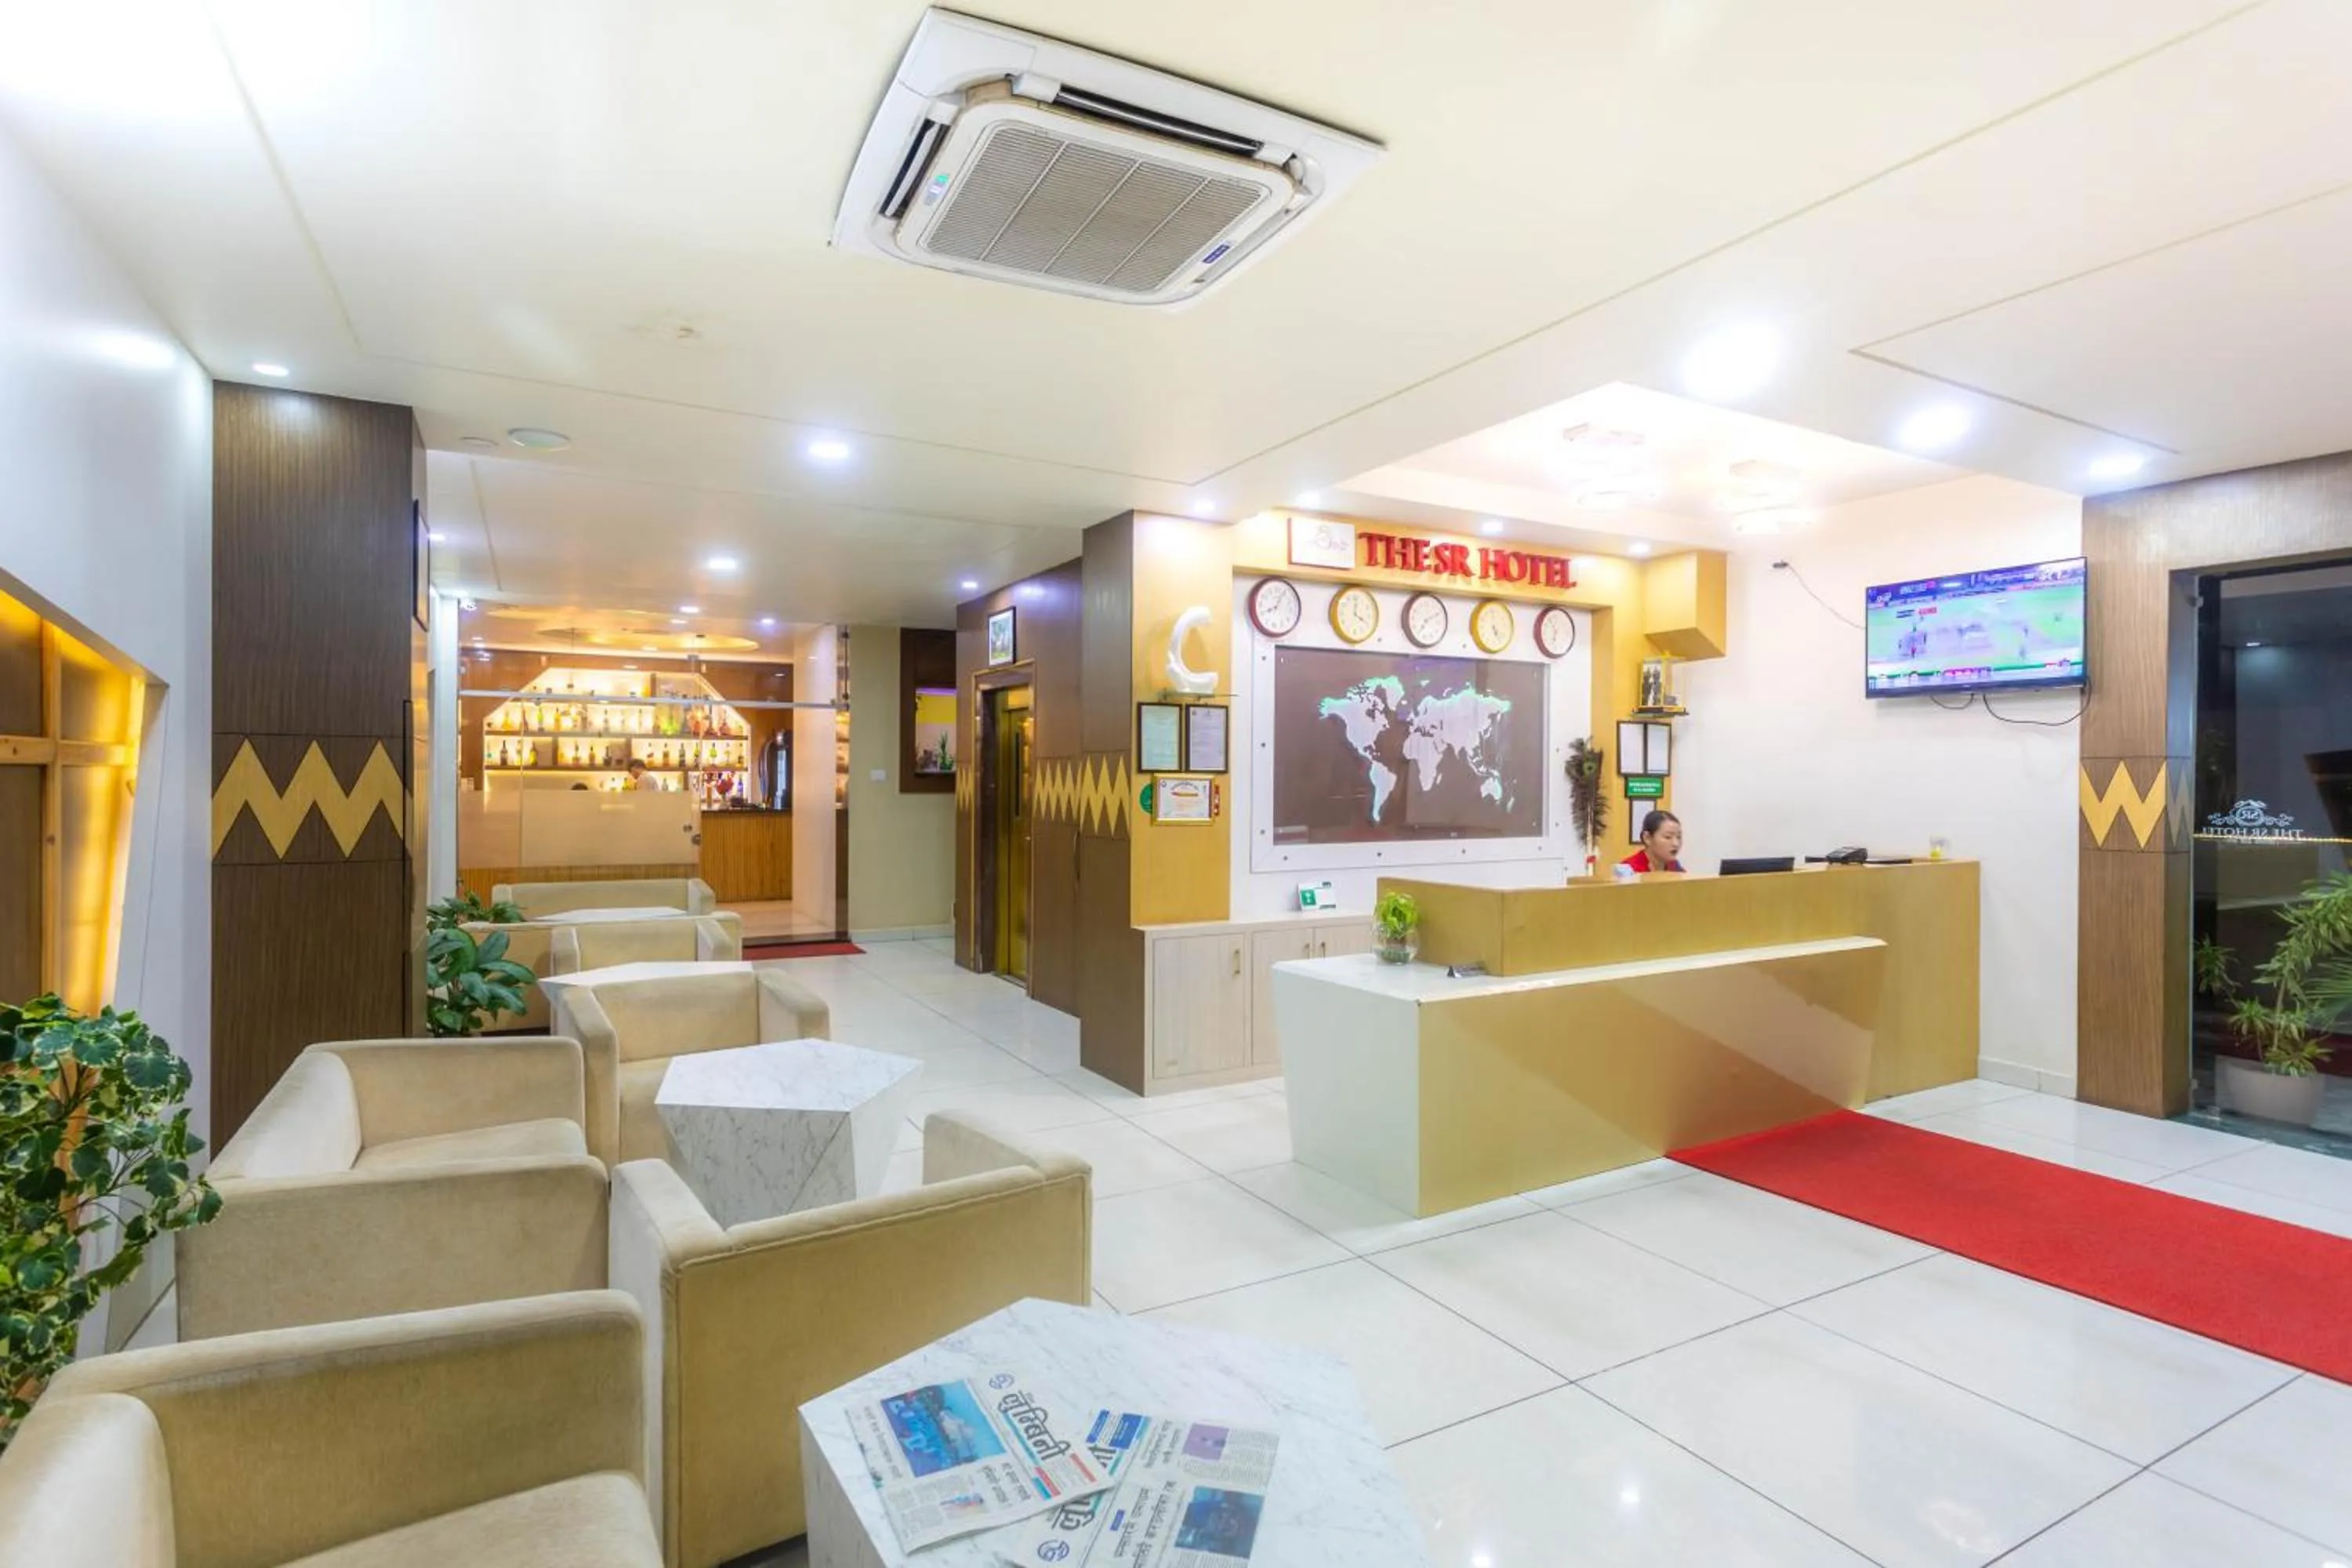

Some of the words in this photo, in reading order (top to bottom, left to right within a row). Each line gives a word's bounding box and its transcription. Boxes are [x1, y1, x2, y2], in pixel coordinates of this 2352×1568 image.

[1358, 532, 1431, 572] THE
[1432, 543, 1474, 577] SR
[1478, 548, 1577, 589] HOTEL
[998, 1390, 1071, 1461] लुम्बिनी
